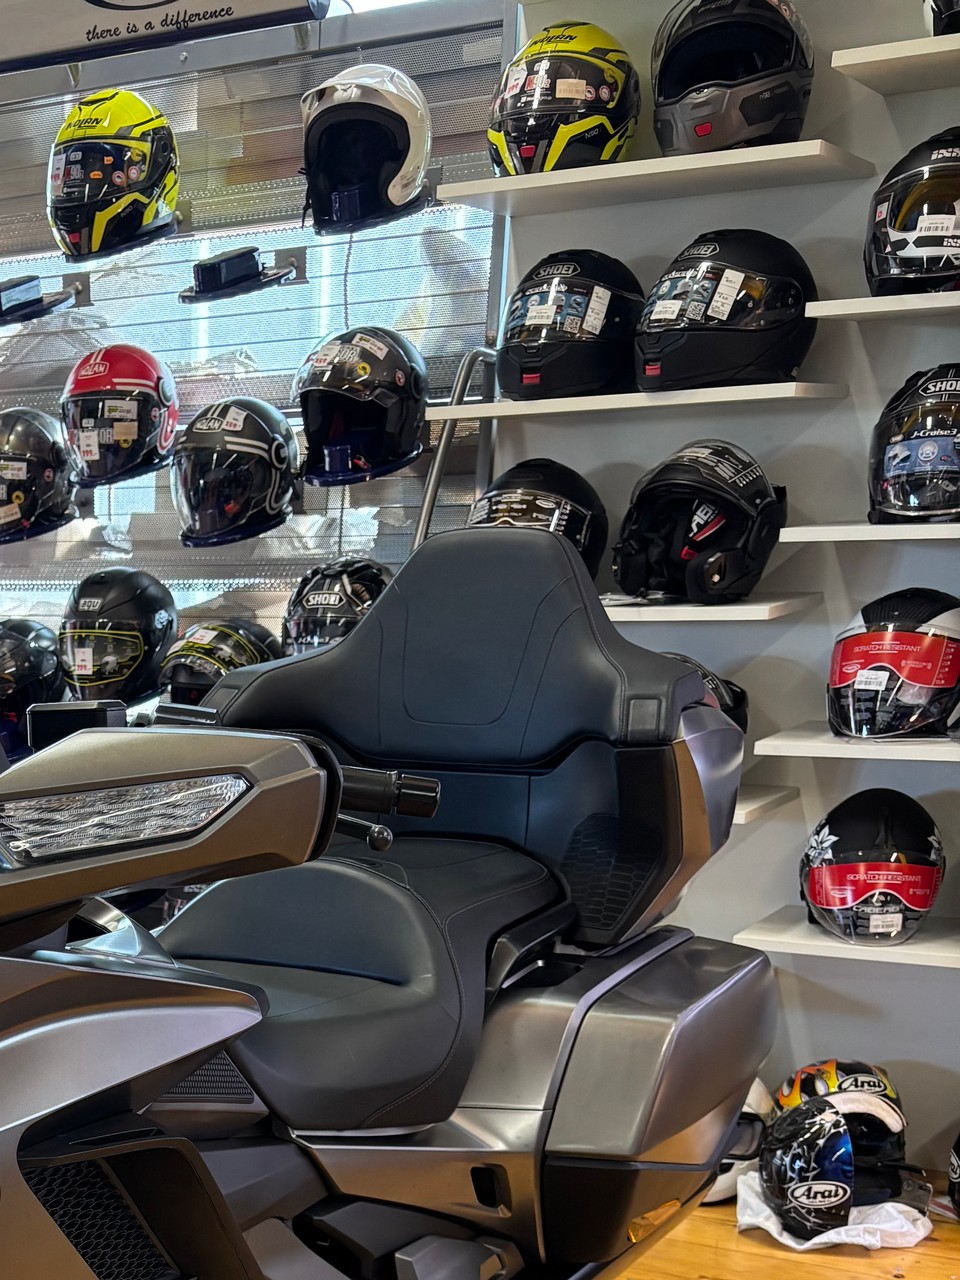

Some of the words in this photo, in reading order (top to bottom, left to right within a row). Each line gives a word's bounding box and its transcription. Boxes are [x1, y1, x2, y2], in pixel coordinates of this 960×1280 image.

[86, 26, 121, 42] there
[126, 22, 138, 34] is
[144, 21, 155, 31] a
[160, 5, 234, 30] difference
[529, 34, 578, 48] NOLAN
[66, 117, 103, 131] NOLAN
[683, 244, 715, 258] SHOEI
[538, 264, 574, 277] SHOEI
[80, 362, 105, 376] NOLAN
[197, 419, 221, 430] NOLAN
[81, 600, 99, 611] agv
[847, 1077, 883, 1089] Arai
[798, 1184, 841, 1200] Arai
